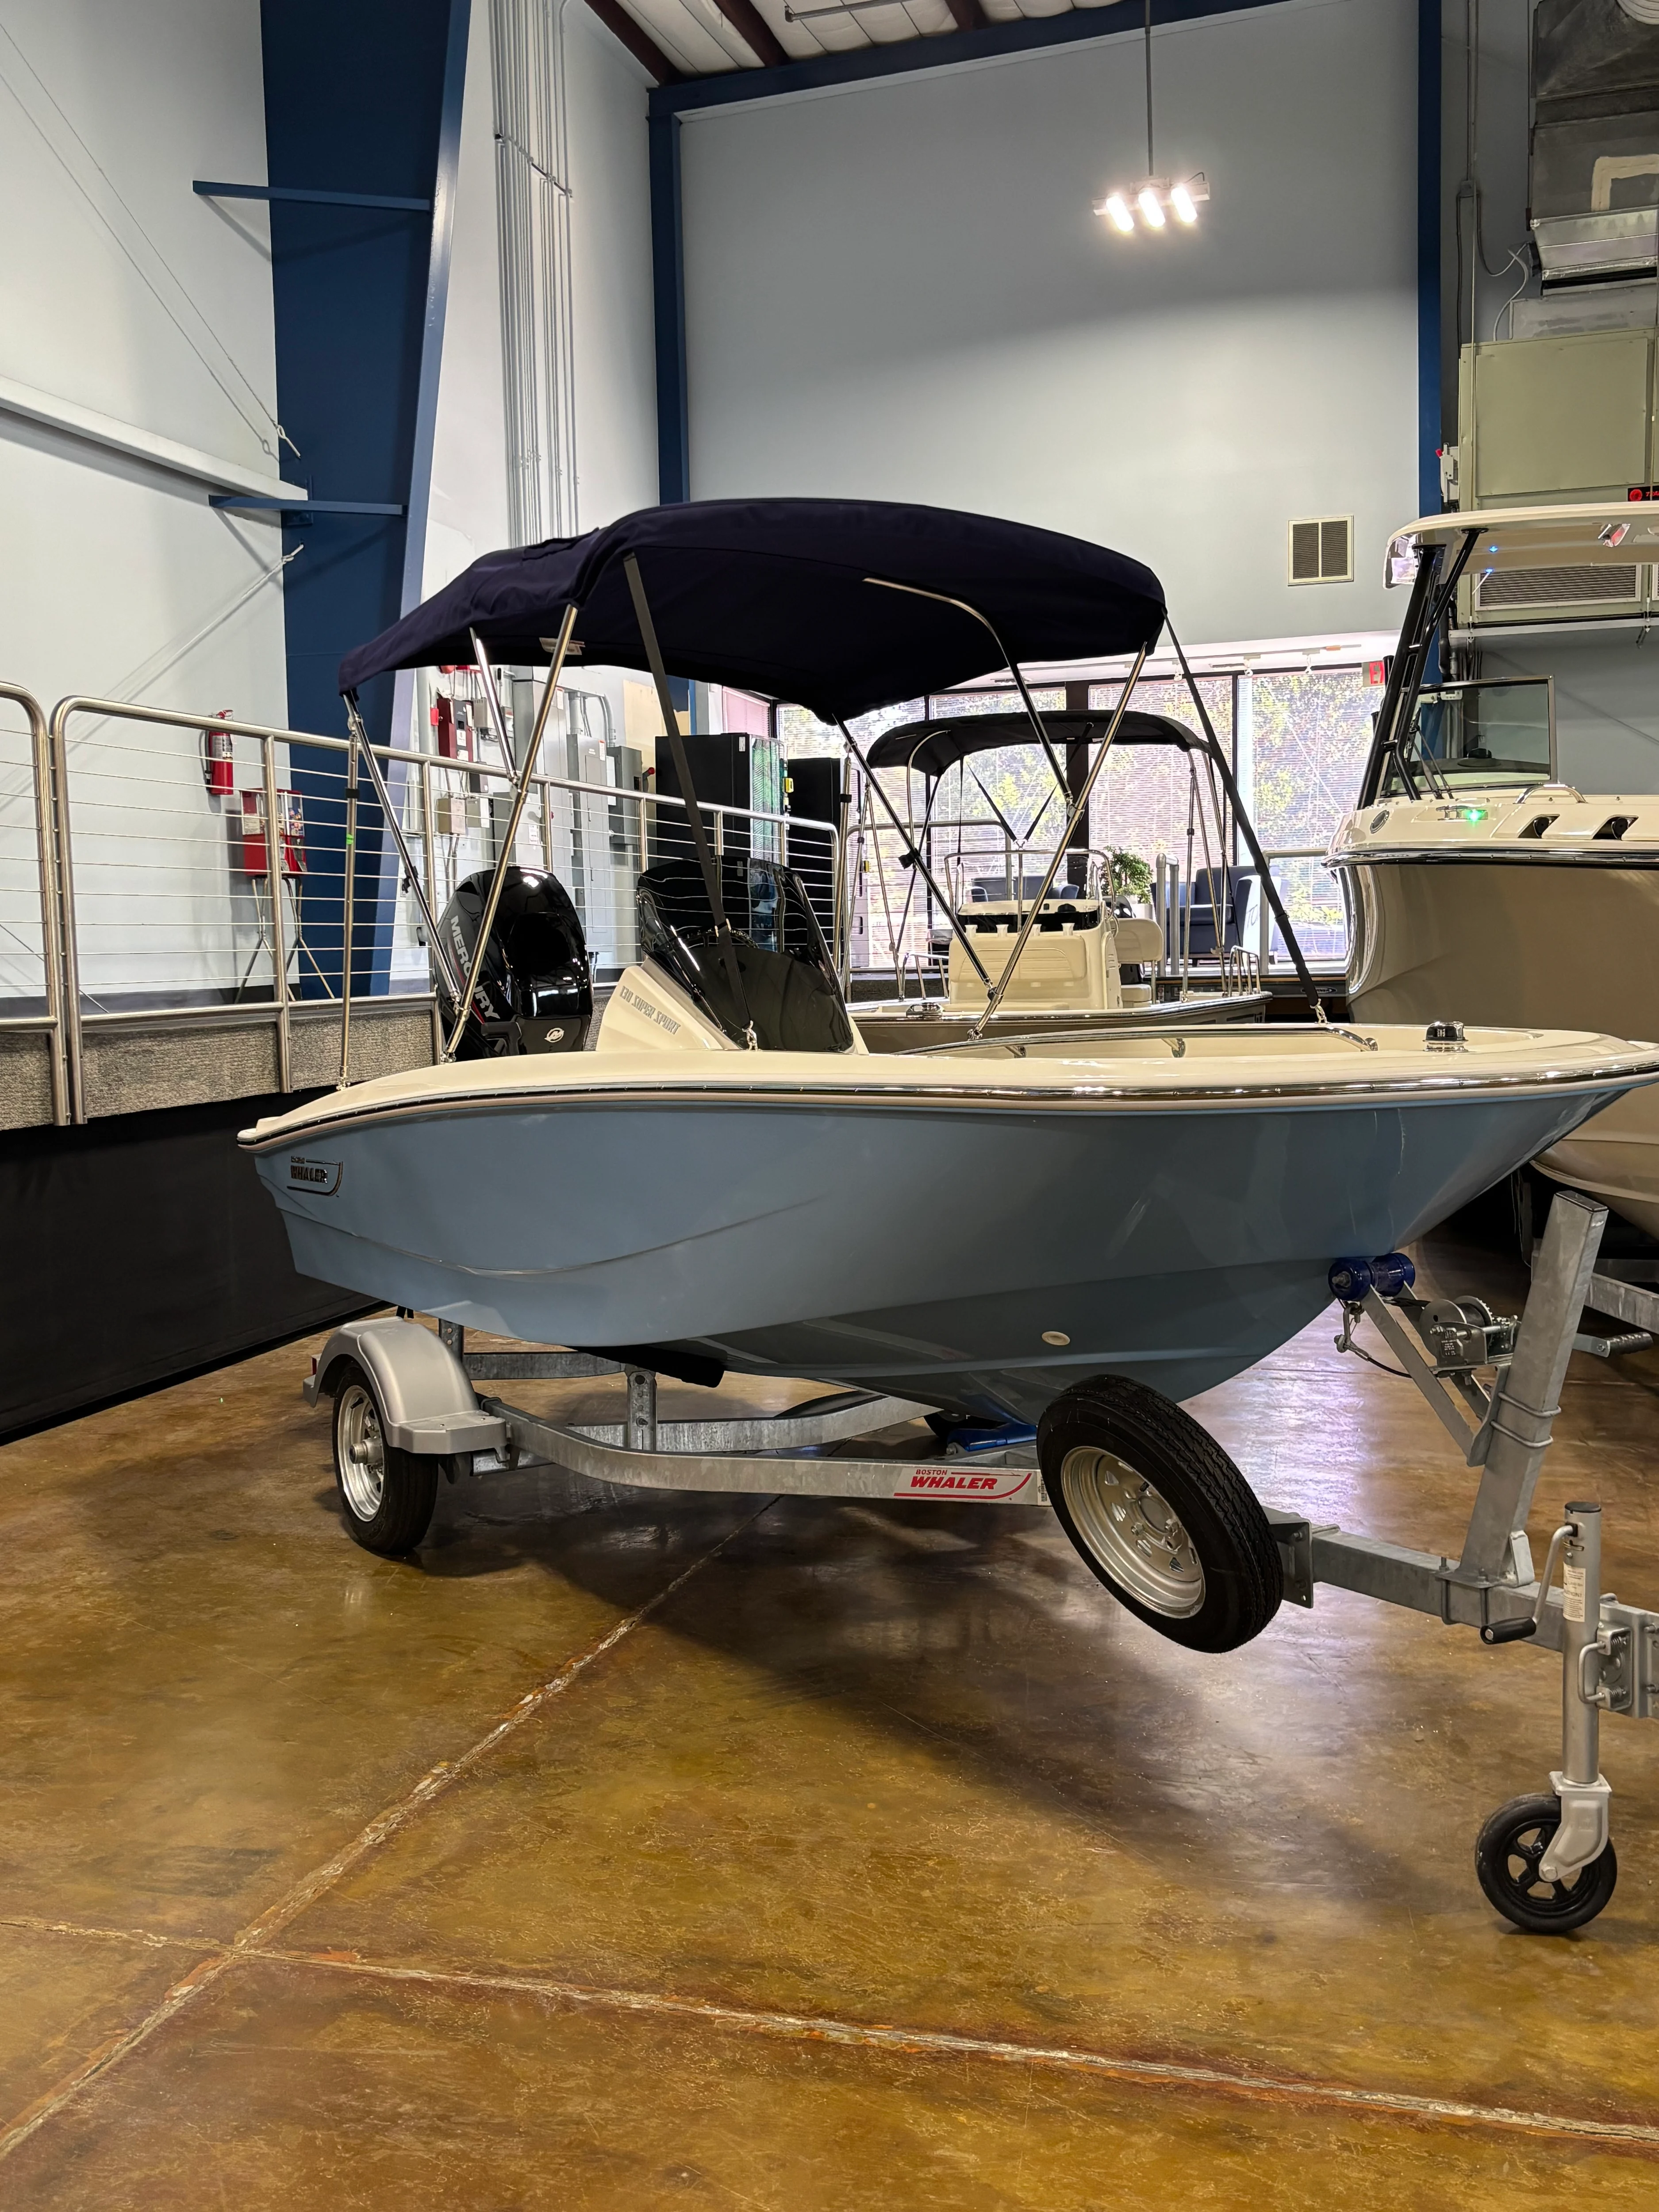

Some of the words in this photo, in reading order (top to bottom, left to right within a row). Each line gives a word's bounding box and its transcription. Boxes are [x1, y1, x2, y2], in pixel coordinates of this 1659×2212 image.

[620, 986, 634, 1002] 130
[631, 995, 656, 1019] SUPER
[653, 1011, 681, 1035] SPORT
[291, 1165, 328, 1183] WHALER
[910, 1476, 997, 1490] WHALER
